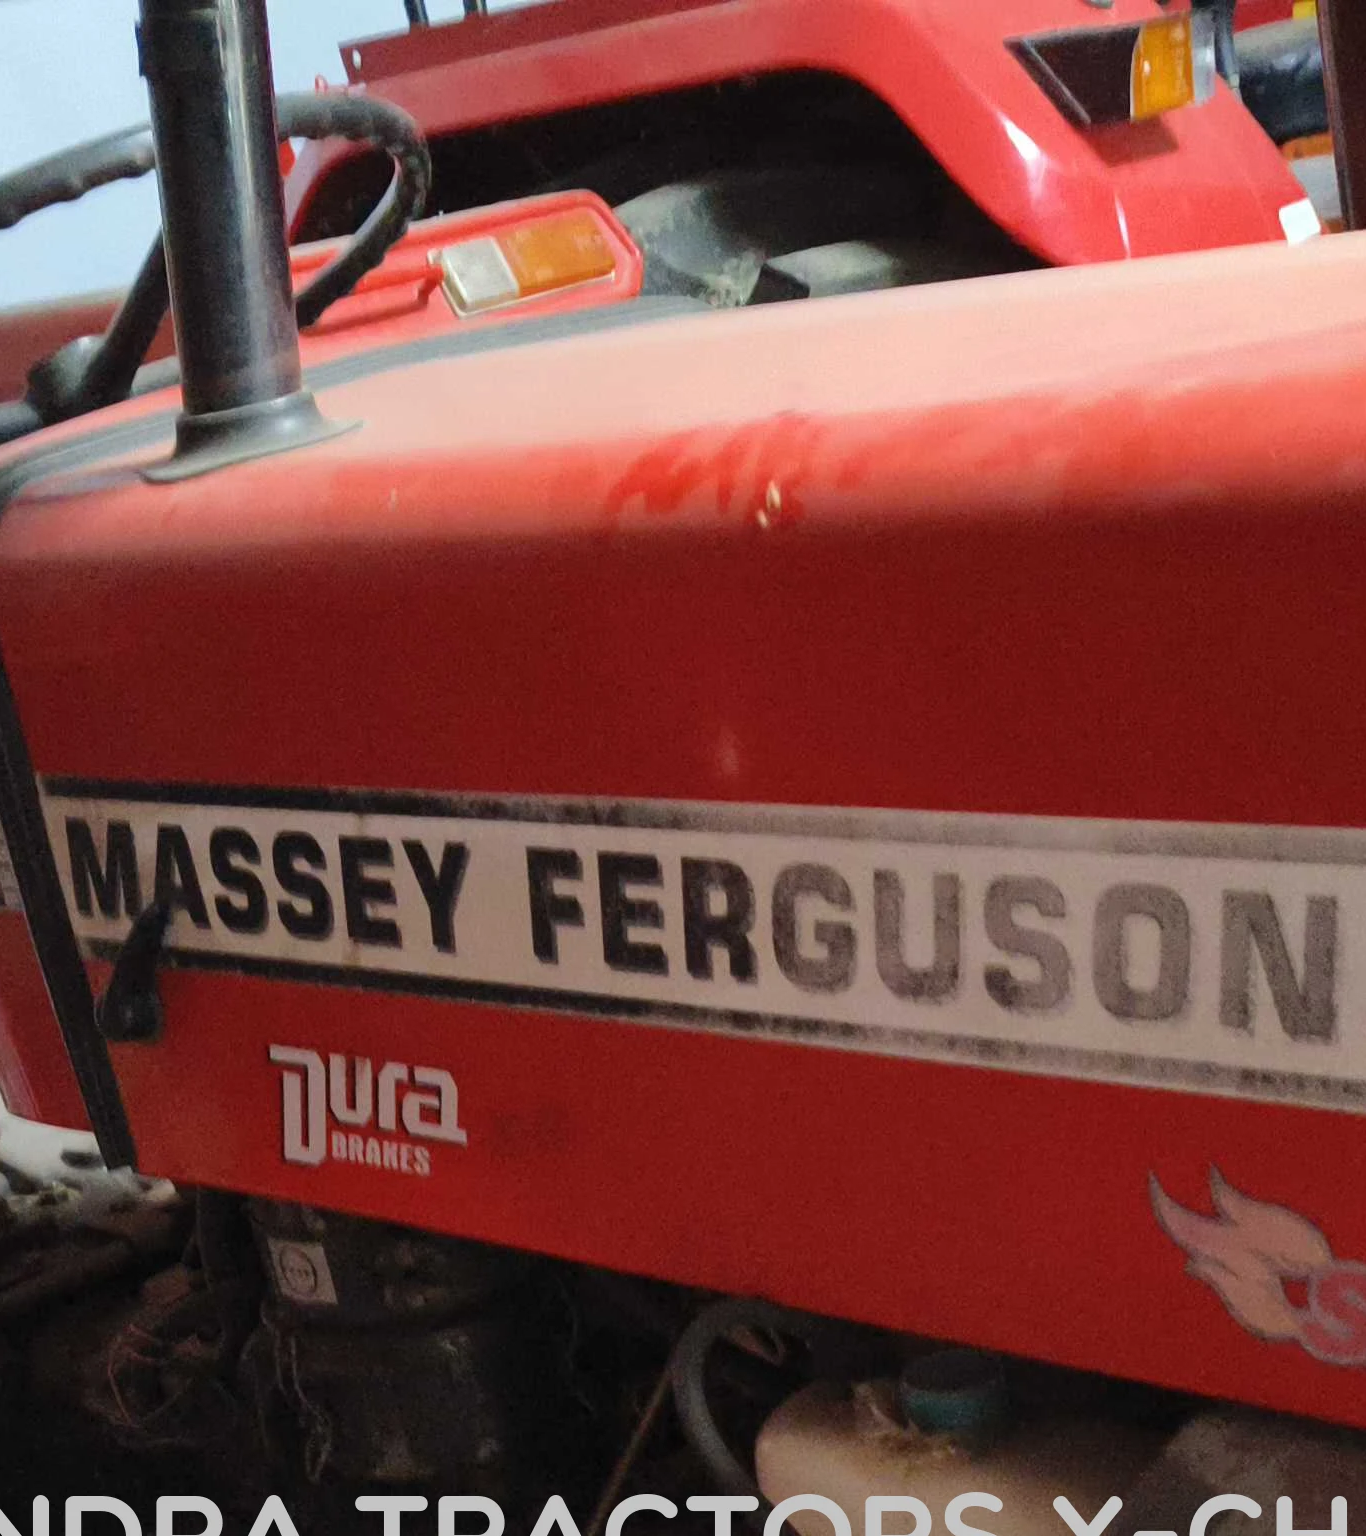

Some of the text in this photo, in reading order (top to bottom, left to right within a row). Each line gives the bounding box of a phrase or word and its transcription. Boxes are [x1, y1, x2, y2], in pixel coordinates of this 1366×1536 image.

[63, 815, 471, 956] MASSEY
[524, 844, 1342, 1047] FERGUSON
[331, 1130, 432, 1178] BRAKES
